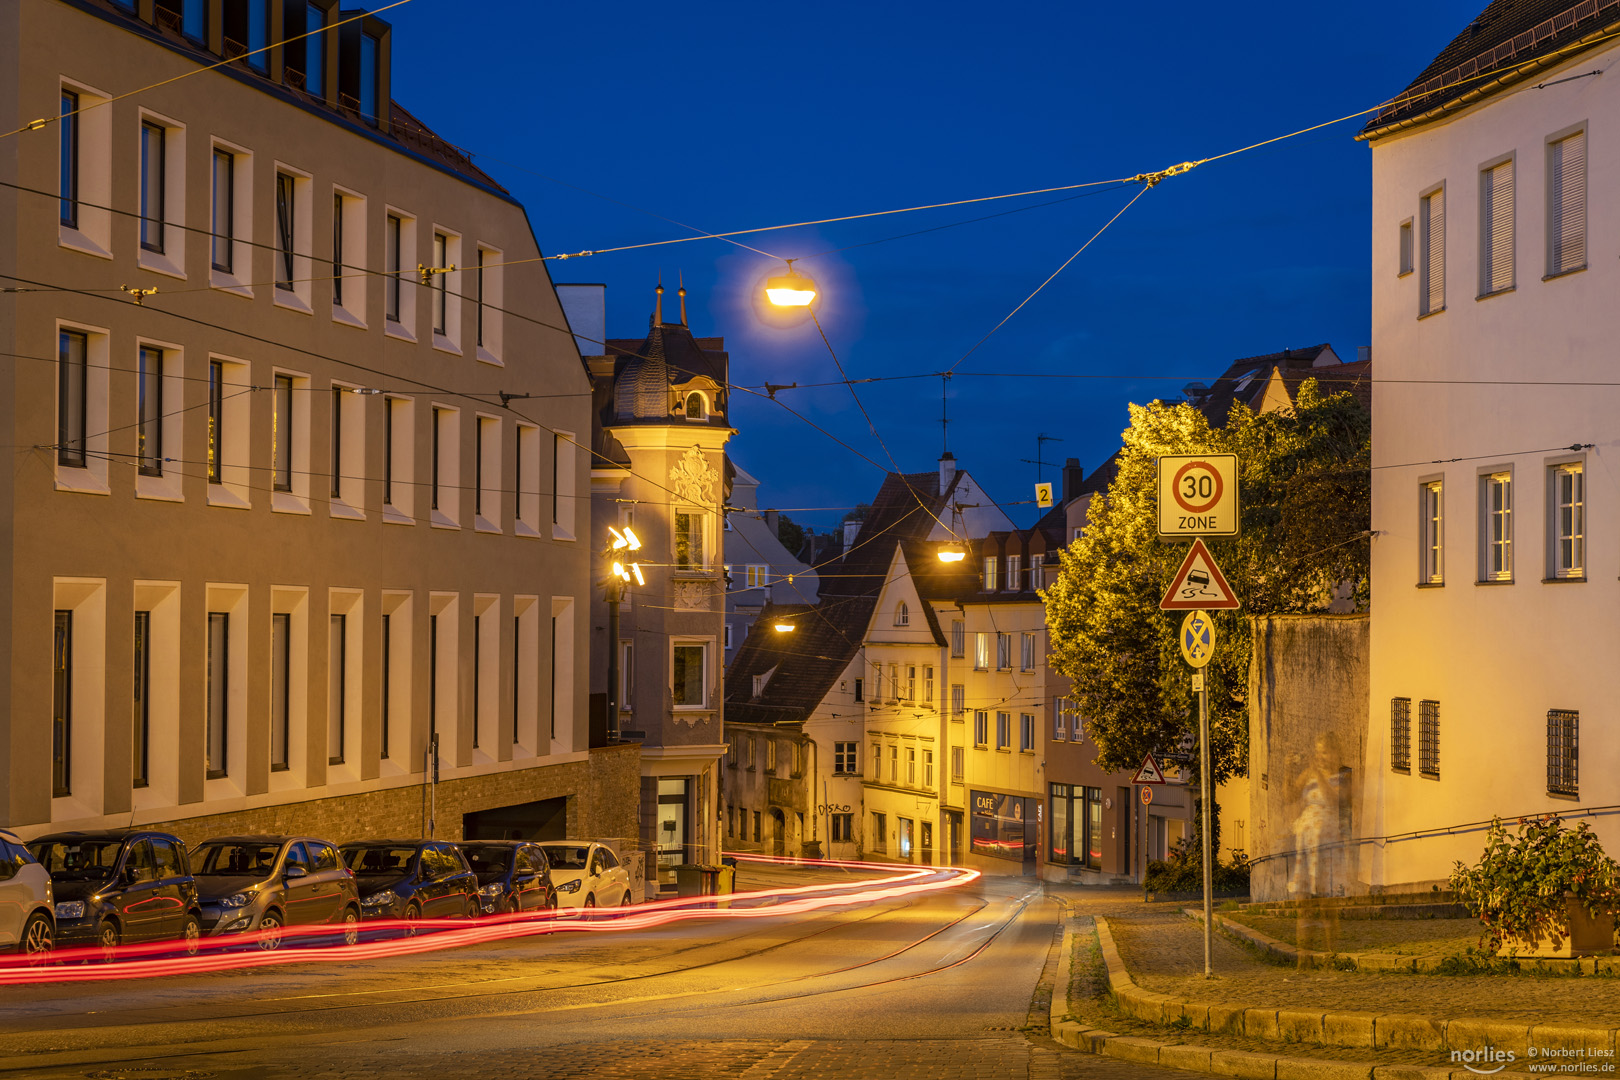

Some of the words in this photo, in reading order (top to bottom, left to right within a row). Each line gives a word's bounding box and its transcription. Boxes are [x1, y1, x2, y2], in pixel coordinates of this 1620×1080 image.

[1183, 475, 1212, 499] 30
[1040, 488, 1048, 501] 2
[1178, 516, 1217, 529] ZONE
